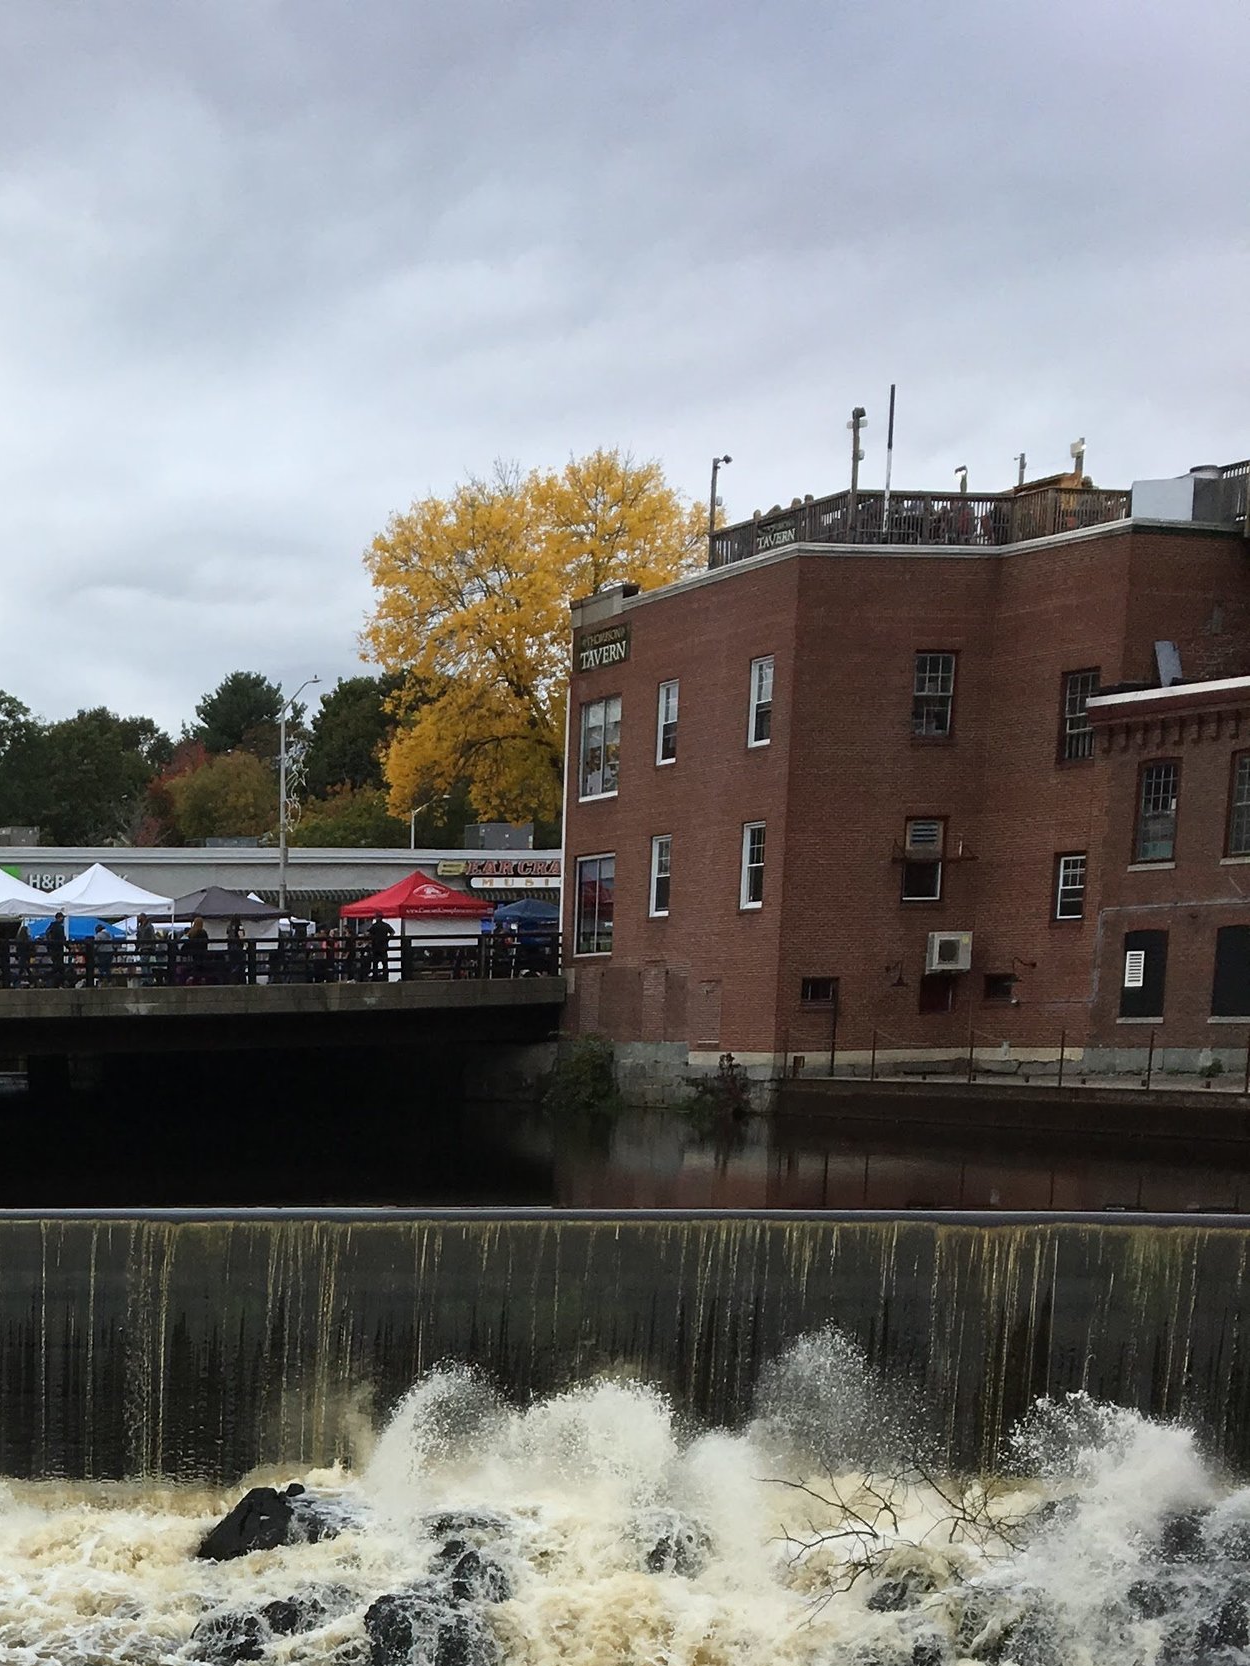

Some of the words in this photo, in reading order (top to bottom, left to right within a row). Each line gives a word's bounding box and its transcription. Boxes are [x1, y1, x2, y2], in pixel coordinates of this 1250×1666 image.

[757, 528, 795, 549] TAVERN
[580, 640, 626, 669] TAVERN
[466, 860, 516, 875] EAR
